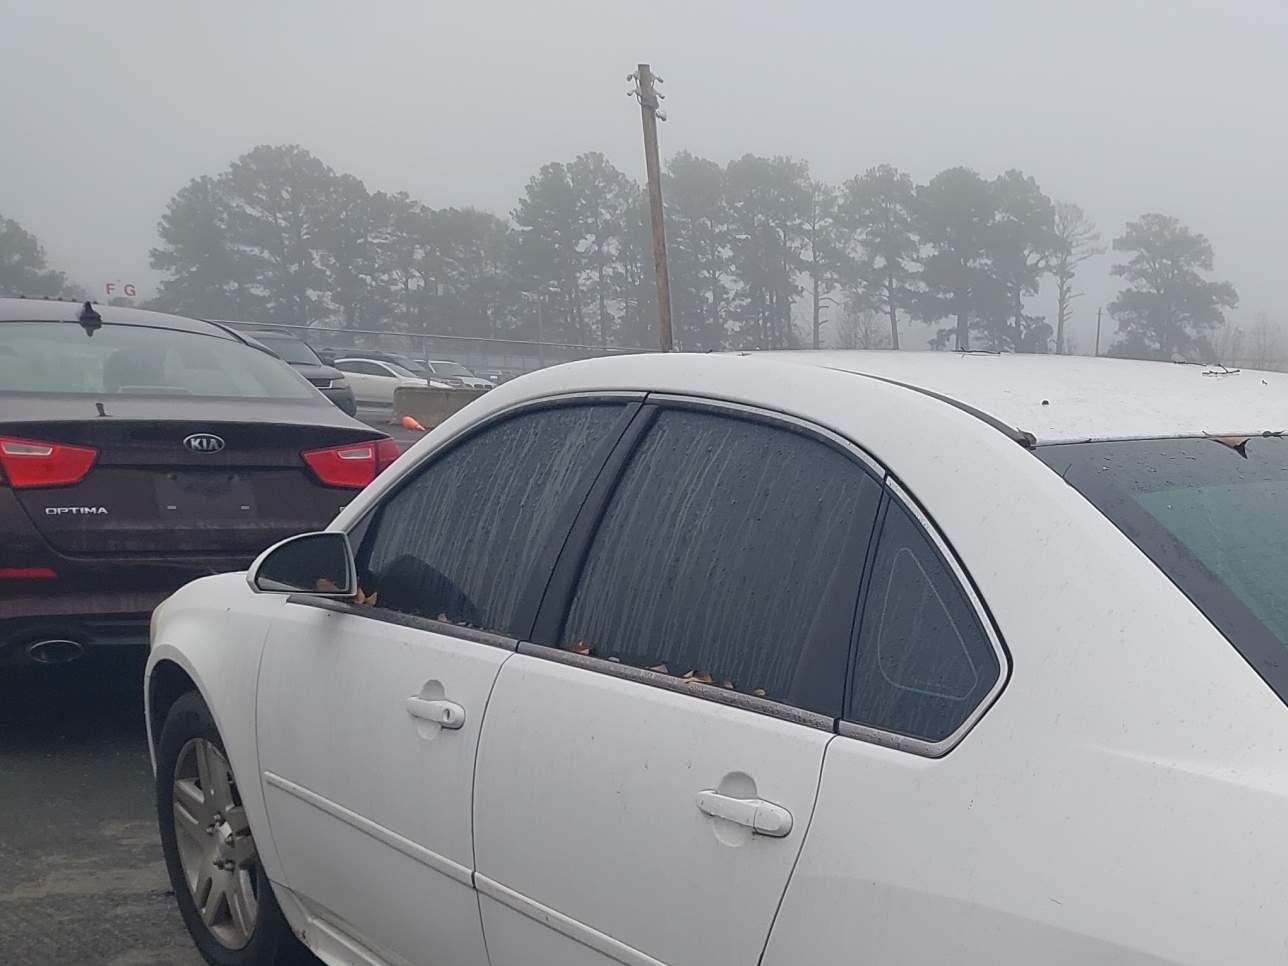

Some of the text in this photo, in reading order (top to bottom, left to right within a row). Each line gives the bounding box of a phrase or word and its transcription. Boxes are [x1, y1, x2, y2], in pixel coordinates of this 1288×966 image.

[106, 283, 116, 295] F
[123, 283, 136, 296] G
[190, 438, 218, 450] KIA
[45, 506, 108, 515] OPTIMA
